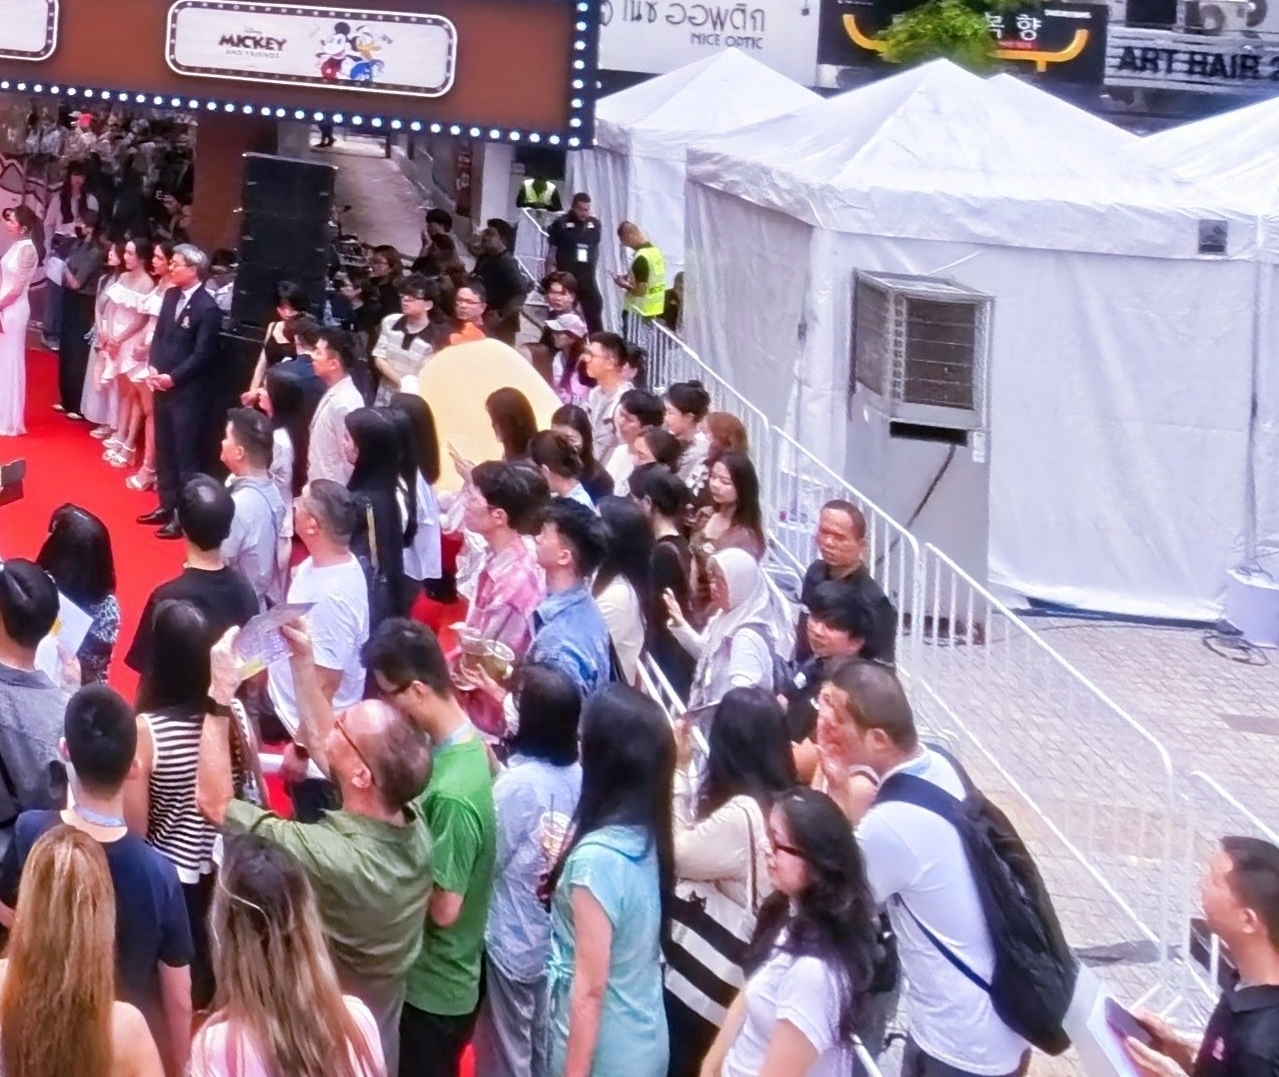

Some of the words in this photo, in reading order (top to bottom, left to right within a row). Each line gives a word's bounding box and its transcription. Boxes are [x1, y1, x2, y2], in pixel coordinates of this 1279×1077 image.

[218, 34, 287, 51] MICKEY
[691, 33, 720, 46] NICE
[725, 35, 764, 49] OPTIC
[1118, 46, 1179, 73] ART
[1188, 50, 1261, 80] HAIR
